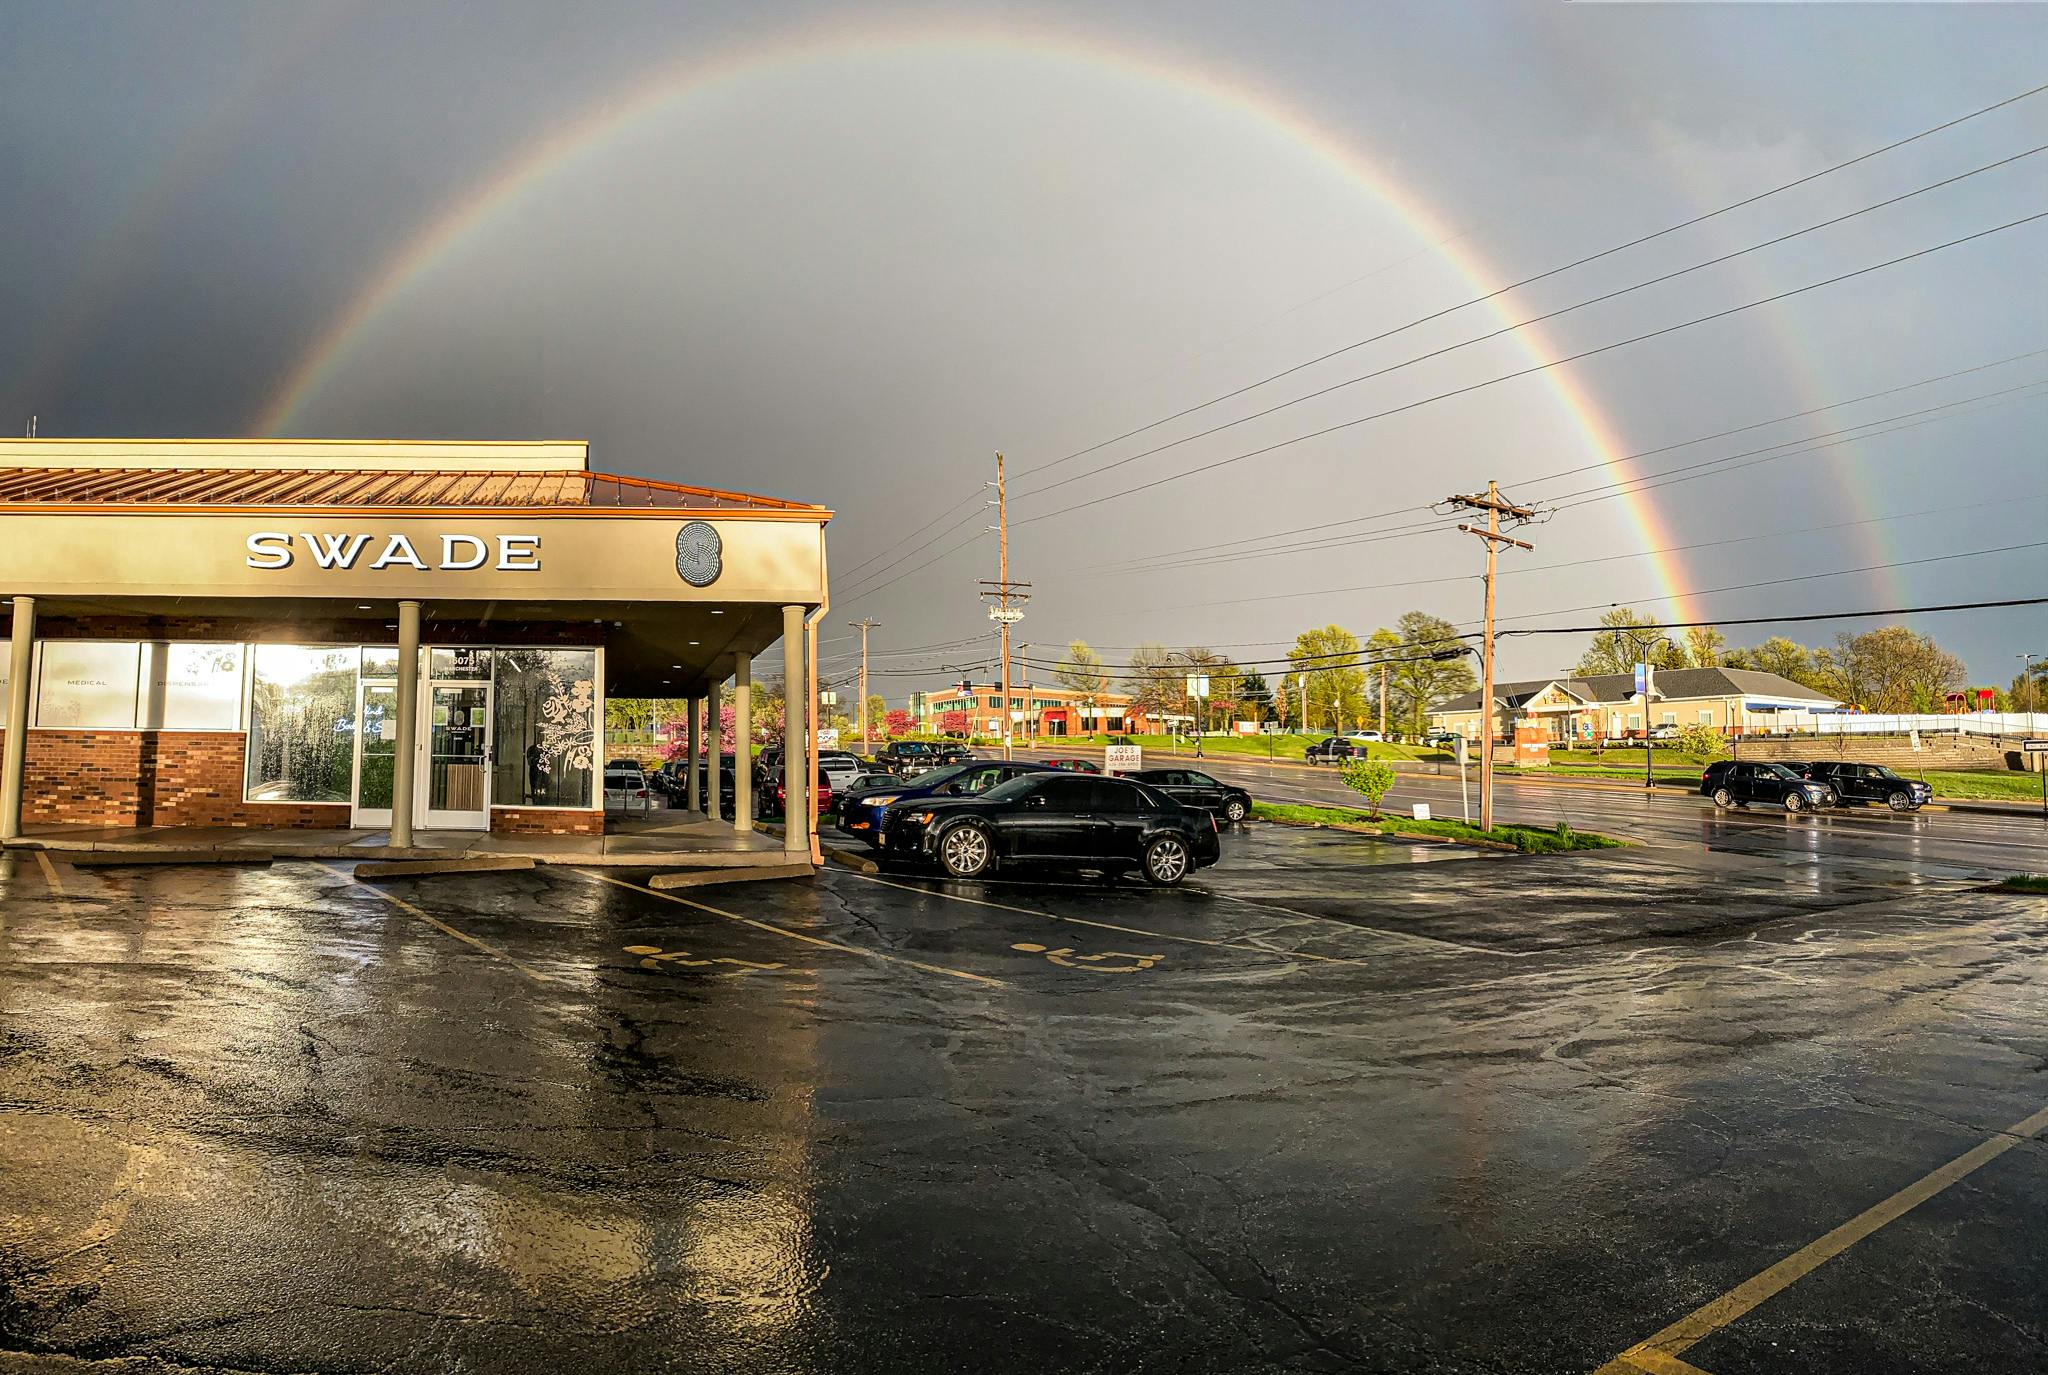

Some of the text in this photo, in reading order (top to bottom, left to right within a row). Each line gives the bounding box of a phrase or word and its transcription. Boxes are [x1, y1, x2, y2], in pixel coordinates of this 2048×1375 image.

[246, 532, 541, 571] SWADE
[448, 656, 475, 665] 16075
[1108, 754, 1140, 762] GARAGE
